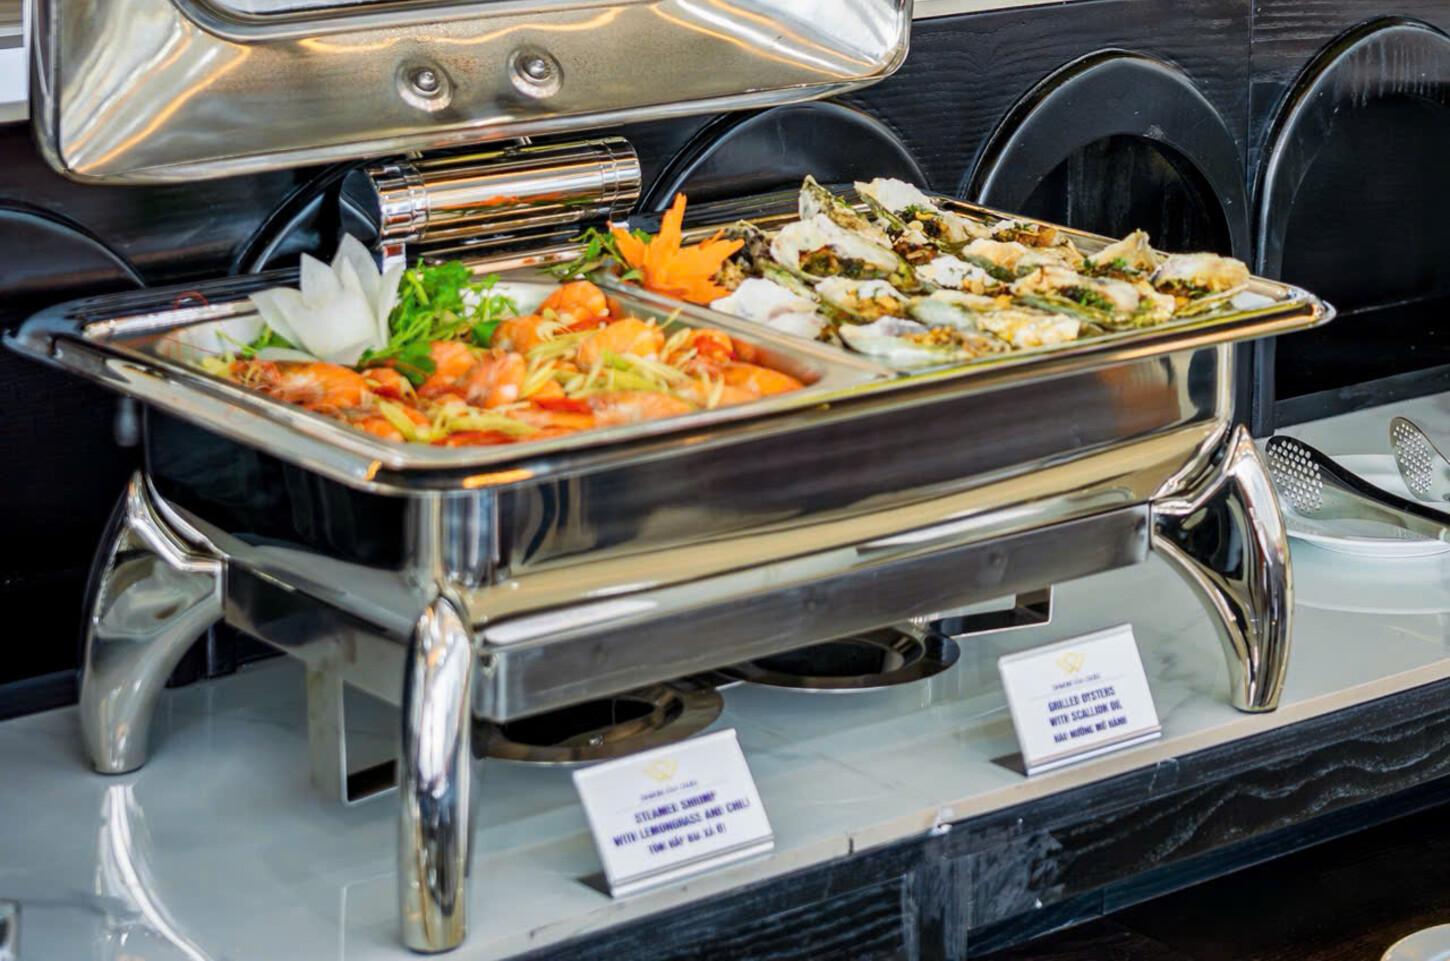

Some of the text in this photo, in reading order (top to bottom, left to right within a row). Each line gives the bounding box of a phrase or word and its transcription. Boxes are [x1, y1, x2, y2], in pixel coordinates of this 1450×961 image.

[1048, 686, 1115, 712] GRILLED OYSTERS
[1050, 700, 1122, 726] WITH SCALLION OIL
[613, 797, 750, 847] WITH LEMONGRASS AND CHILI
[634, 791, 717, 824] STEAMED SHRIMP
